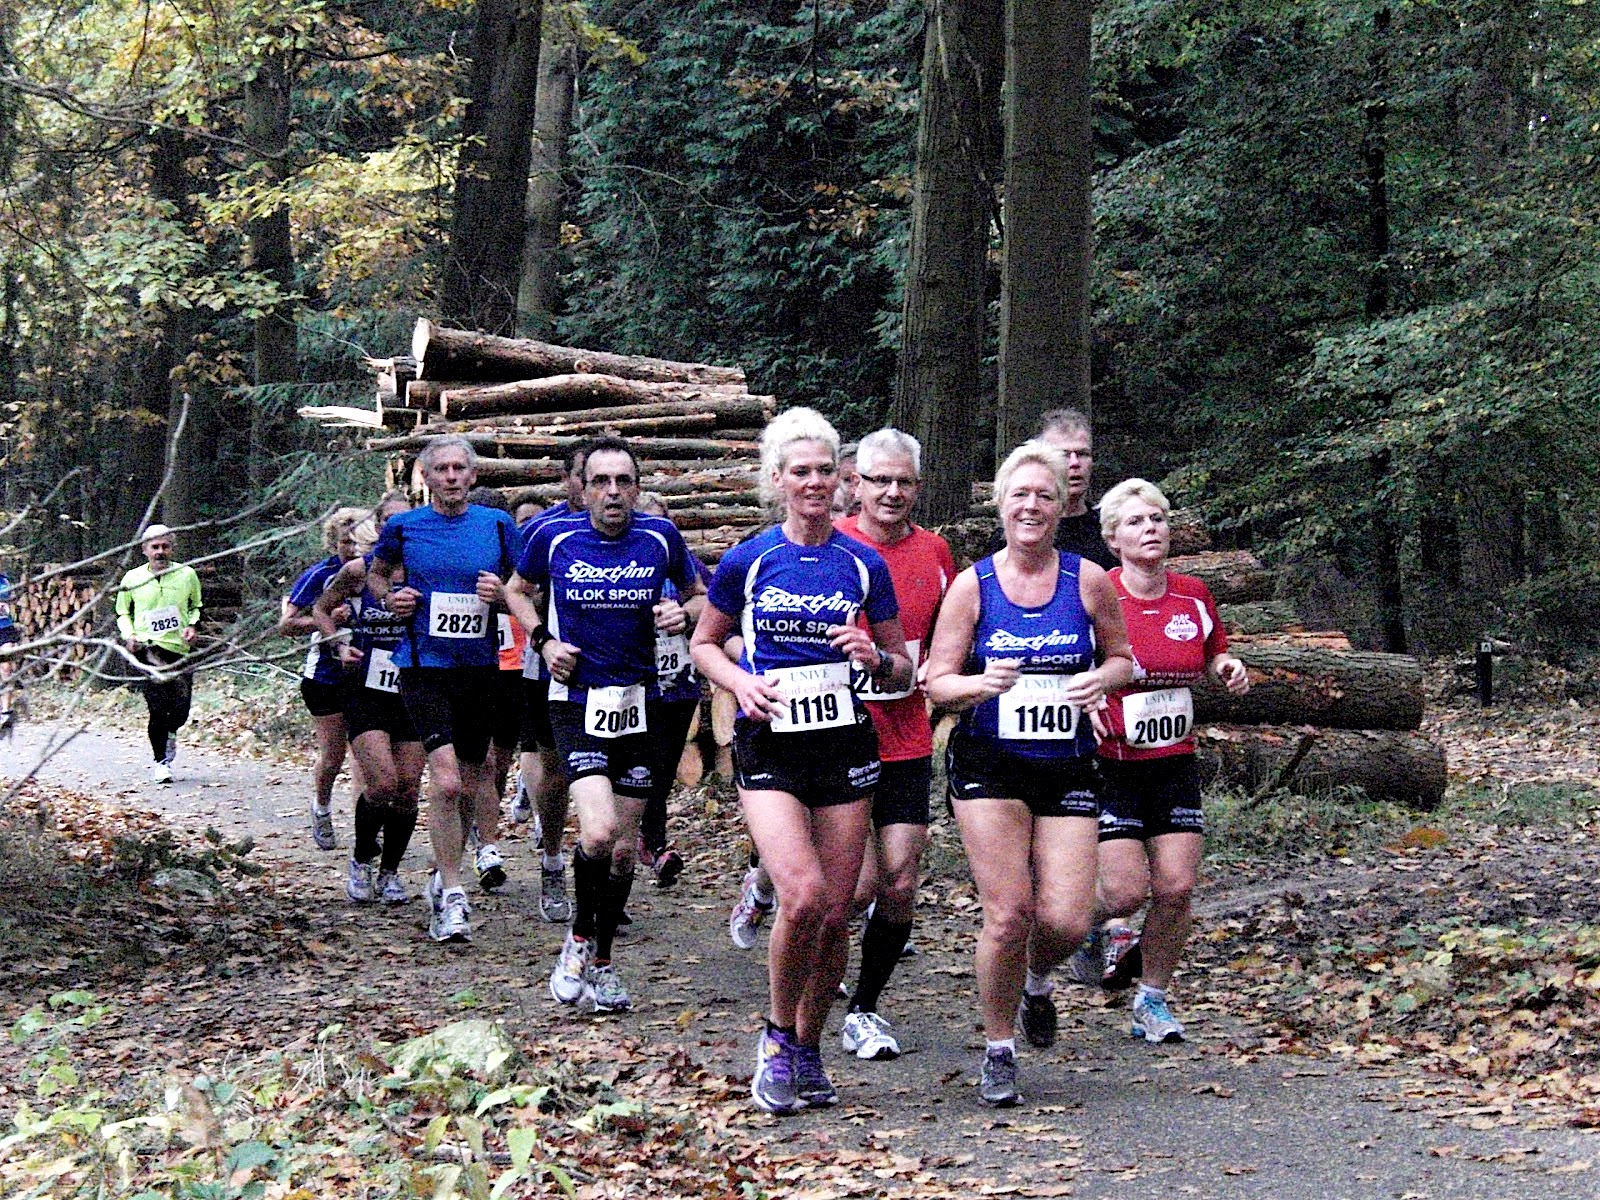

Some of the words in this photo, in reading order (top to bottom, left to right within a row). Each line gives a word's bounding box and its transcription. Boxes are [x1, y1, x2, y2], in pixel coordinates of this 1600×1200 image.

[565, 588, 605, 601] KLOK
[608, 588, 654, 601] SPORT
[151, 616, 179, 632] 2825
[363, 626, 390, 635] KLOK
[437, 613, 483, 634] 2823
[756, 618, 802, 633] KLOK
[1031, 653, 1082, 665] SPORT
[789, 693, 839, 725] 1119
[594, 705, 639, 733] 2008
[1014, 704, 1072, 733] 1140
[1134, 714, 1187, 745] 2000
